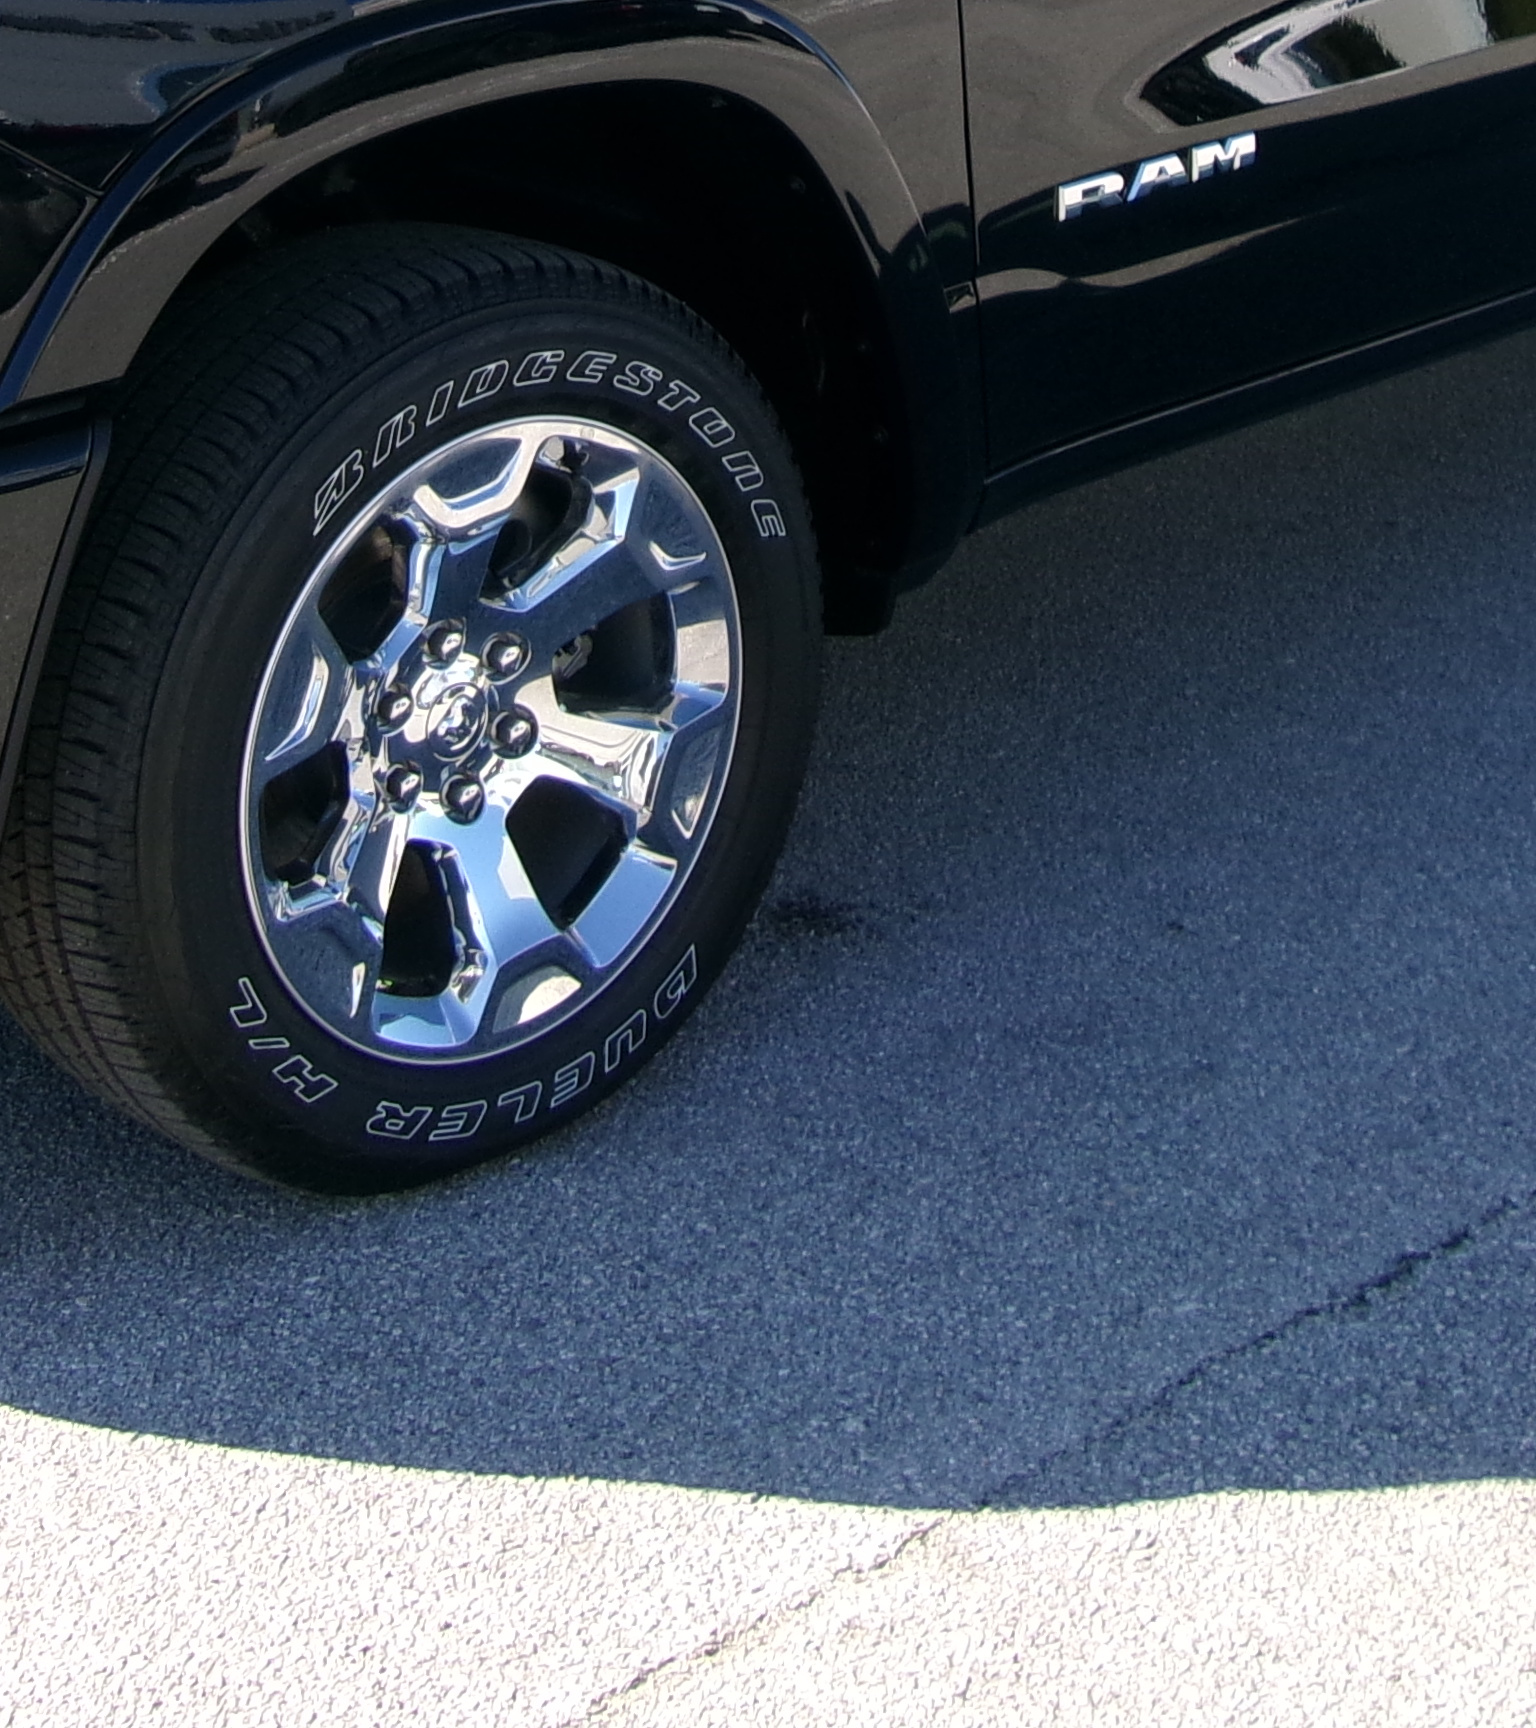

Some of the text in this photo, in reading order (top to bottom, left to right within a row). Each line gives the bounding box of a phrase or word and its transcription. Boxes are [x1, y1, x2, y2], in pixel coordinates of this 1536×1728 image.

[1056, 130, 1256, 222] RAM
[312, 349, 787, 539] BRIDGESTONE
[229, 942, 698, 1142] DUELER H/L
